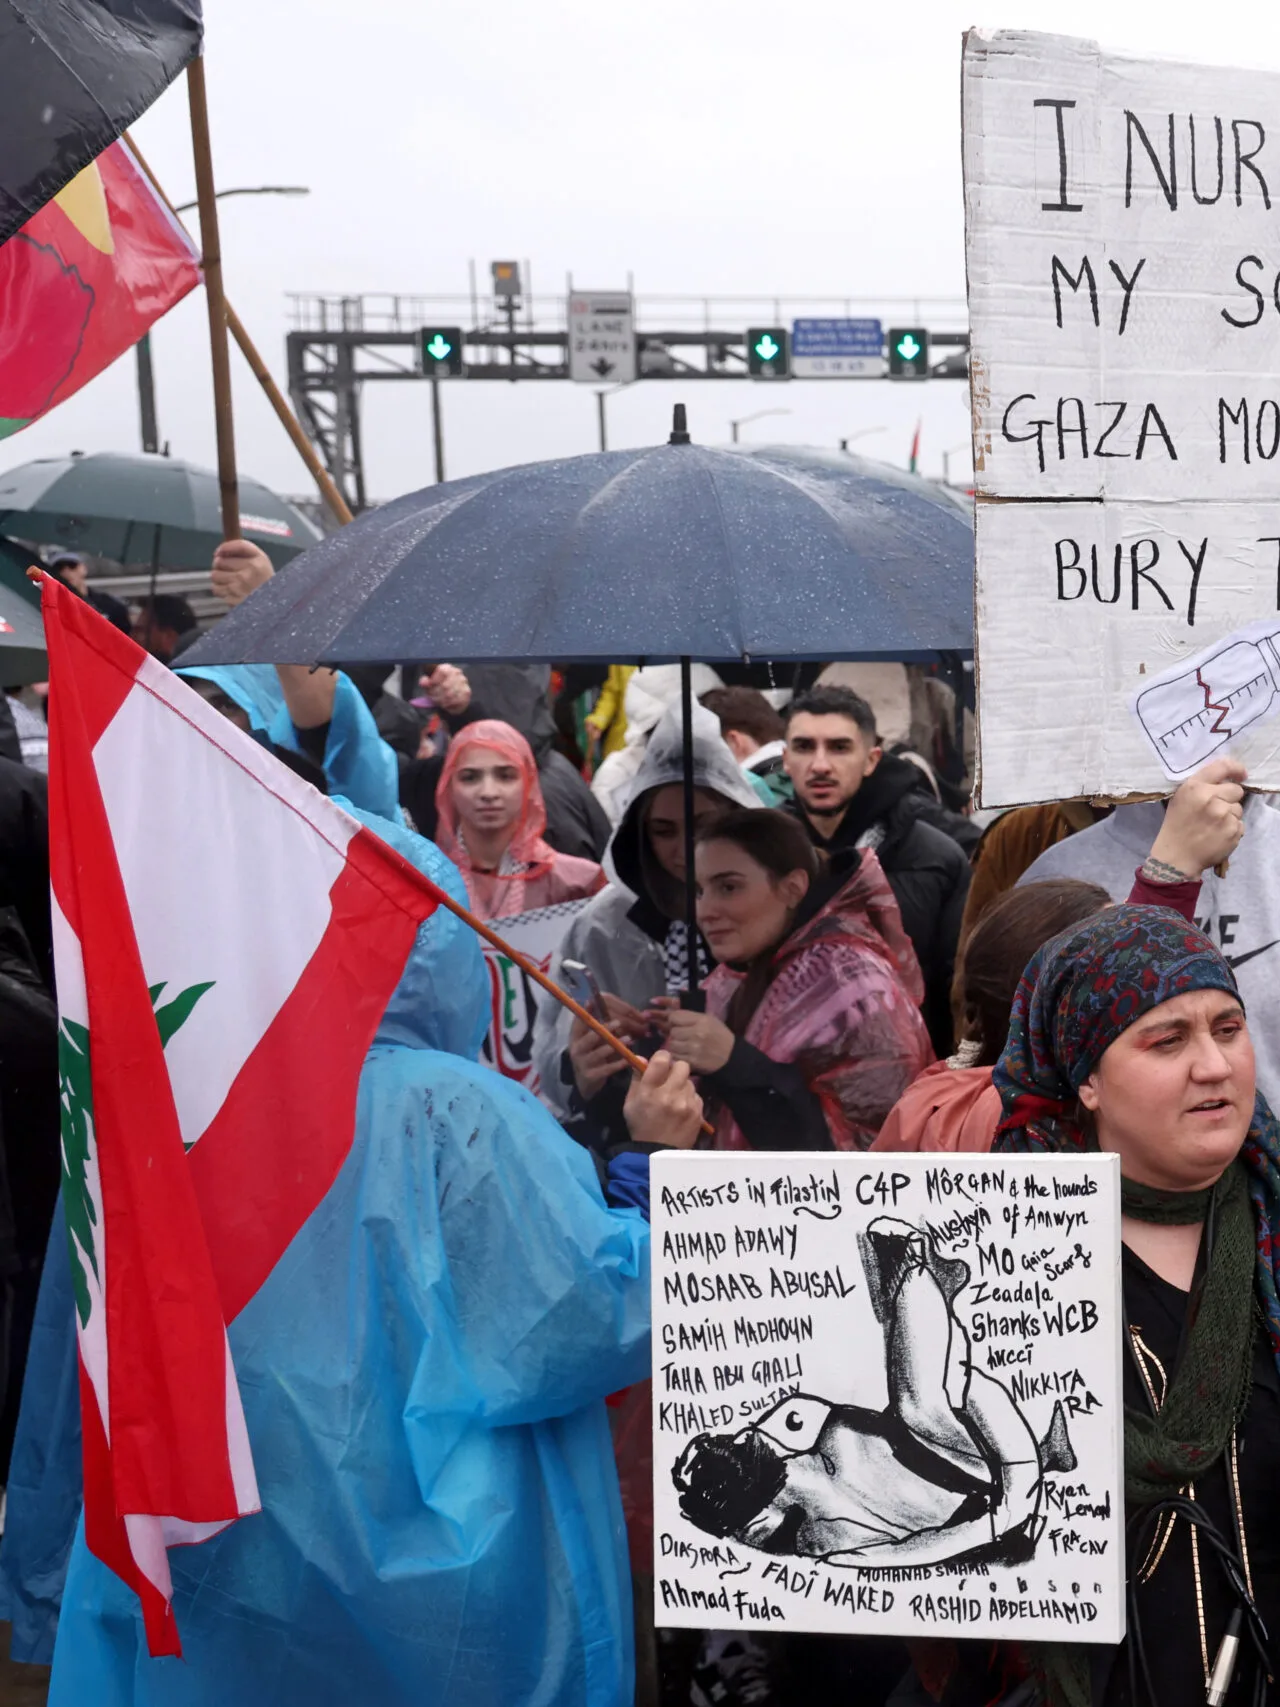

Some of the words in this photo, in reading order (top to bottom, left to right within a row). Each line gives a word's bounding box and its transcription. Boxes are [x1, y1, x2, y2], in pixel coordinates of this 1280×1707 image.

[1033, 98, 1083, 212] I
[1050, 254, 1147, 336] MY
[1001, 393, 1178, 473] GAZA
[1054, 536, 1208, 627] BURY
[661, 1181, 740, 1217] ARTISTS
[856, 1171, 911, 1206] C4P
[1024, 1174, 1050, 1199] the
[1052, 1174, 1098, 1200] hounds
[663, 1230, 726, 1264] AHMAD
[734, 1224, 797, 1260] ADAWY
[975, 1242, 1015, 1276] MO
[663, 1271, 763, 1307] MOSAAB
[770, 1265, 857, 1299] ABUSAL
[972, 1310, 1041, 1343] Shanks
[1043, 1299, 1099, 1337] WCB
[660, 1361, 708, 1396] TAHA
[751, 1353, 803, 1388] GHALI
[1011, 1368, 1086, 1402] NIKKITA
[659, 1402, 734, 1435] KHALED
[739, 1381, 801, 1416] SULTAN
[660, 1532, 740, 1569] DIASPORA
[659, 1579, 730, 1613] Ahmad
[734, 1589, 786, 1621] Fuda
[823, 1577, 895, 1614] WAKED
[909, 1593, 982, 1624] RASHID
[989, 1597, 1098, 1624] ABDELHAMID
